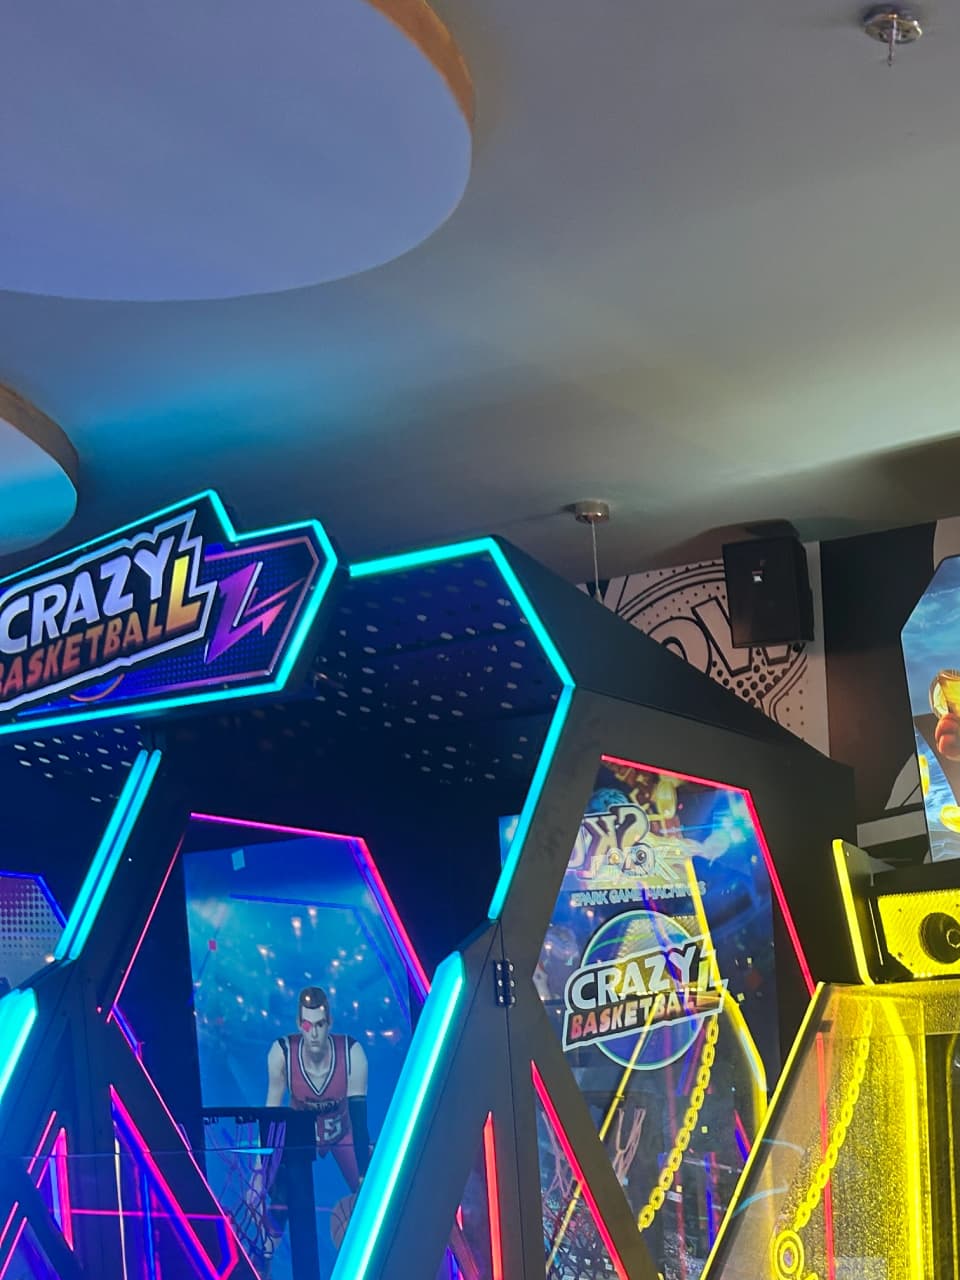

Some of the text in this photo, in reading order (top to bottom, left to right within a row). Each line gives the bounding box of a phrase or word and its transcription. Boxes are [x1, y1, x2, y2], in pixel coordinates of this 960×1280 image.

[0, 535, 175, 655] CRAZY
[0, 555, 201, 698] ASKETBALL
[570, 888, 610, 908] SPARK
[648, 880, 707, 901] MACHINS
[571, 944, 697, 1010] CRAZY
